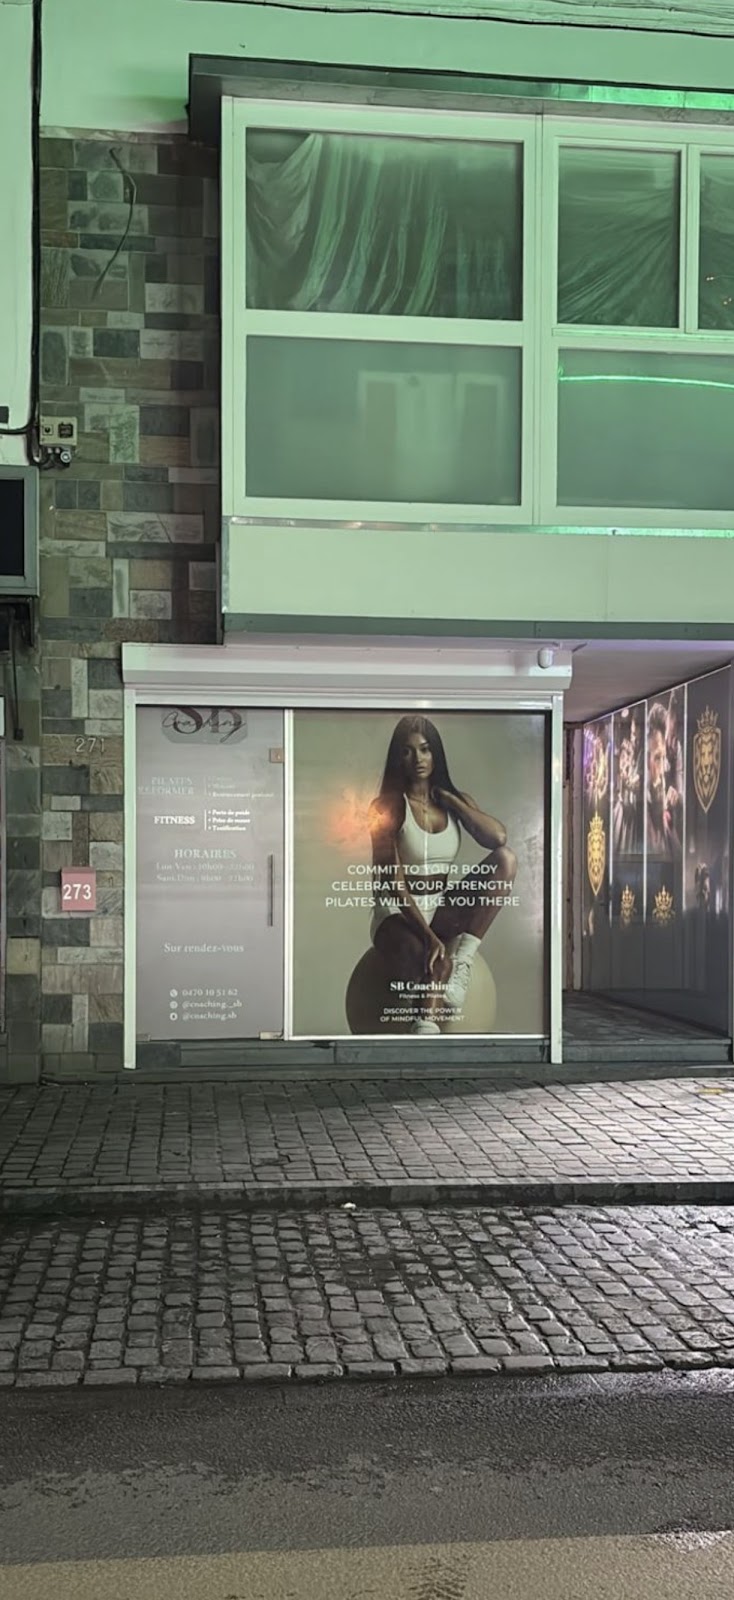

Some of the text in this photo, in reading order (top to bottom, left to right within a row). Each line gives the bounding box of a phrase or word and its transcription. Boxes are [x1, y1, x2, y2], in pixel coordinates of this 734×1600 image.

[75, 737, 105, 752] 271
[154, 815, 196, 825] FITNESS
[174, 848, 237, 859] HORAIRES
[347, 863, 498, 875] COMMIT TO YOUR BODY
[331, 880, 513, 891] CELEBRATE YOUR STRENGTH
[62, 884, 92, 900] 273
[325, 896, 520, 907] PILATES WILL TAKE YOU THERE
[164, 942, 245, 953] Sur rendez-vous
[389, 981, 405, 991] SB
[182, 988, 203, 996] 0470
[205, 988, 215, 996] 10
[216, 988, 226, 997] 51
[383, 1007, 419, 1015] DISCOVER
